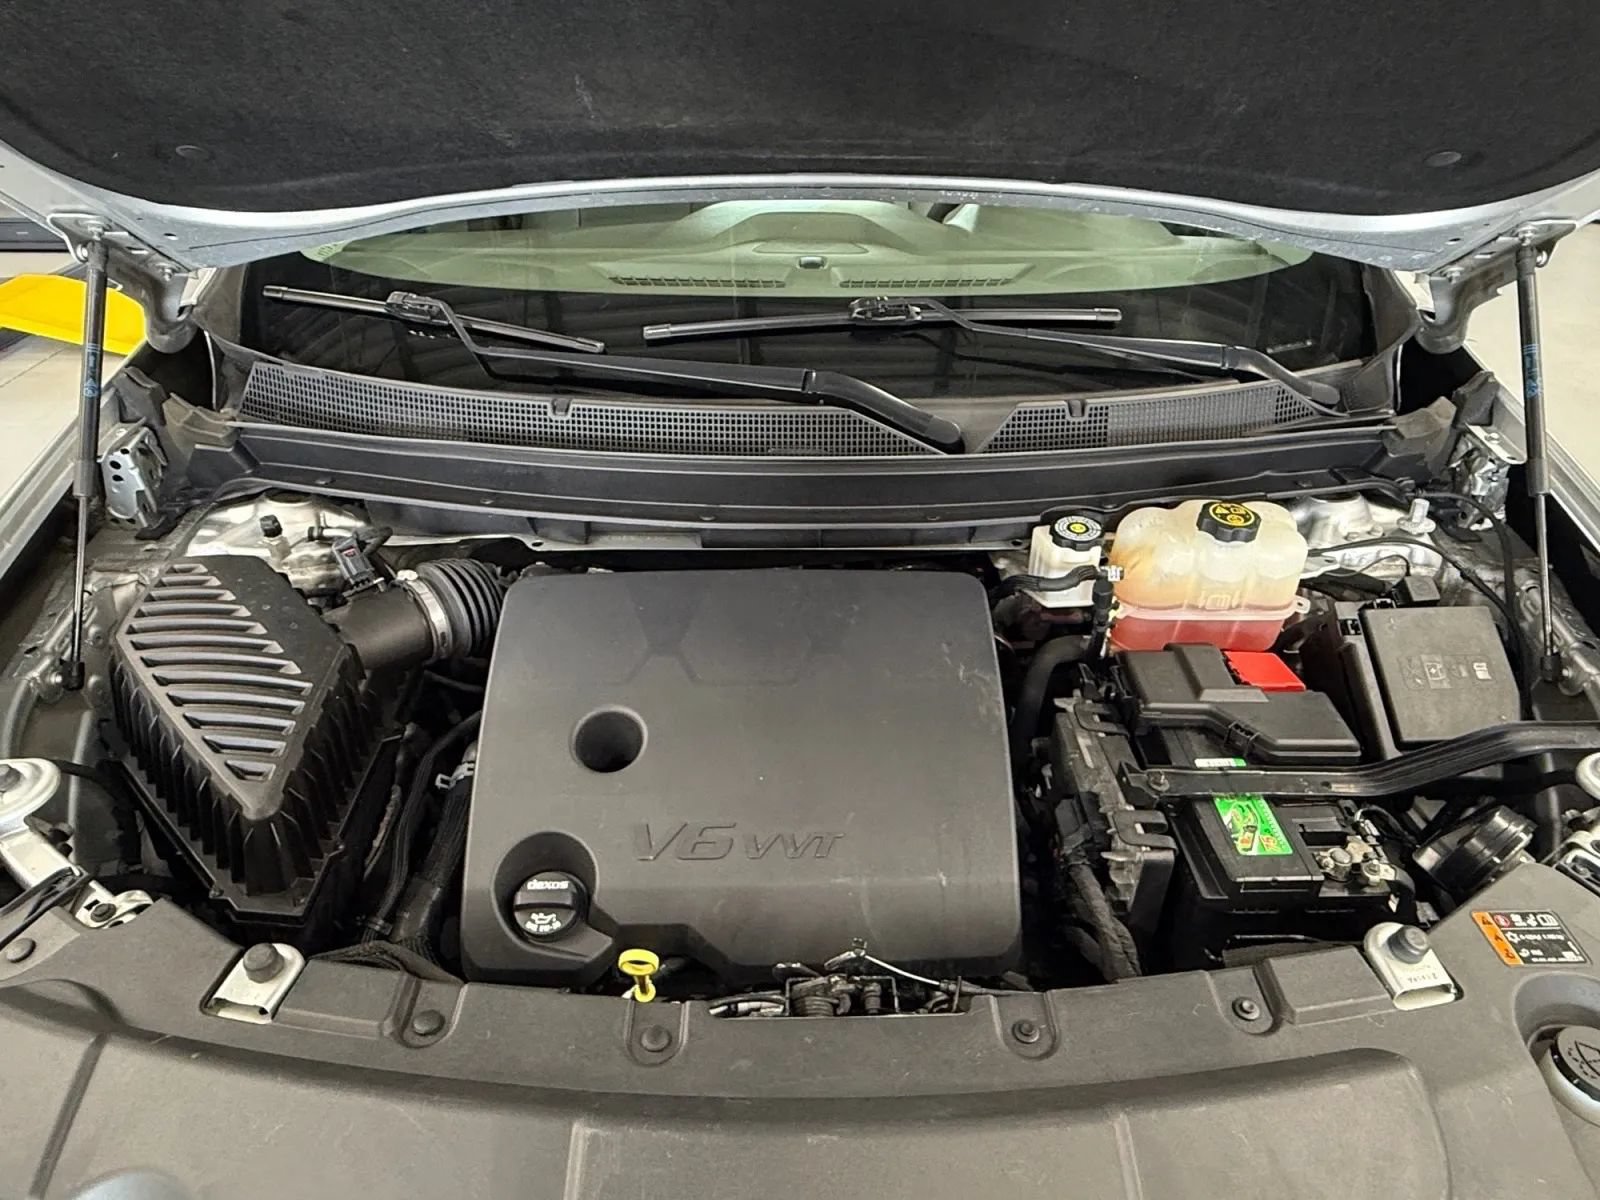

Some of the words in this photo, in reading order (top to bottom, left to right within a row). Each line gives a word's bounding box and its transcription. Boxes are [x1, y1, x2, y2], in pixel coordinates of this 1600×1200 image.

[634, 822, 738, 861] V6
[746, 832, 846, 860] VVT
[526, 879, 569, 891] dexos
